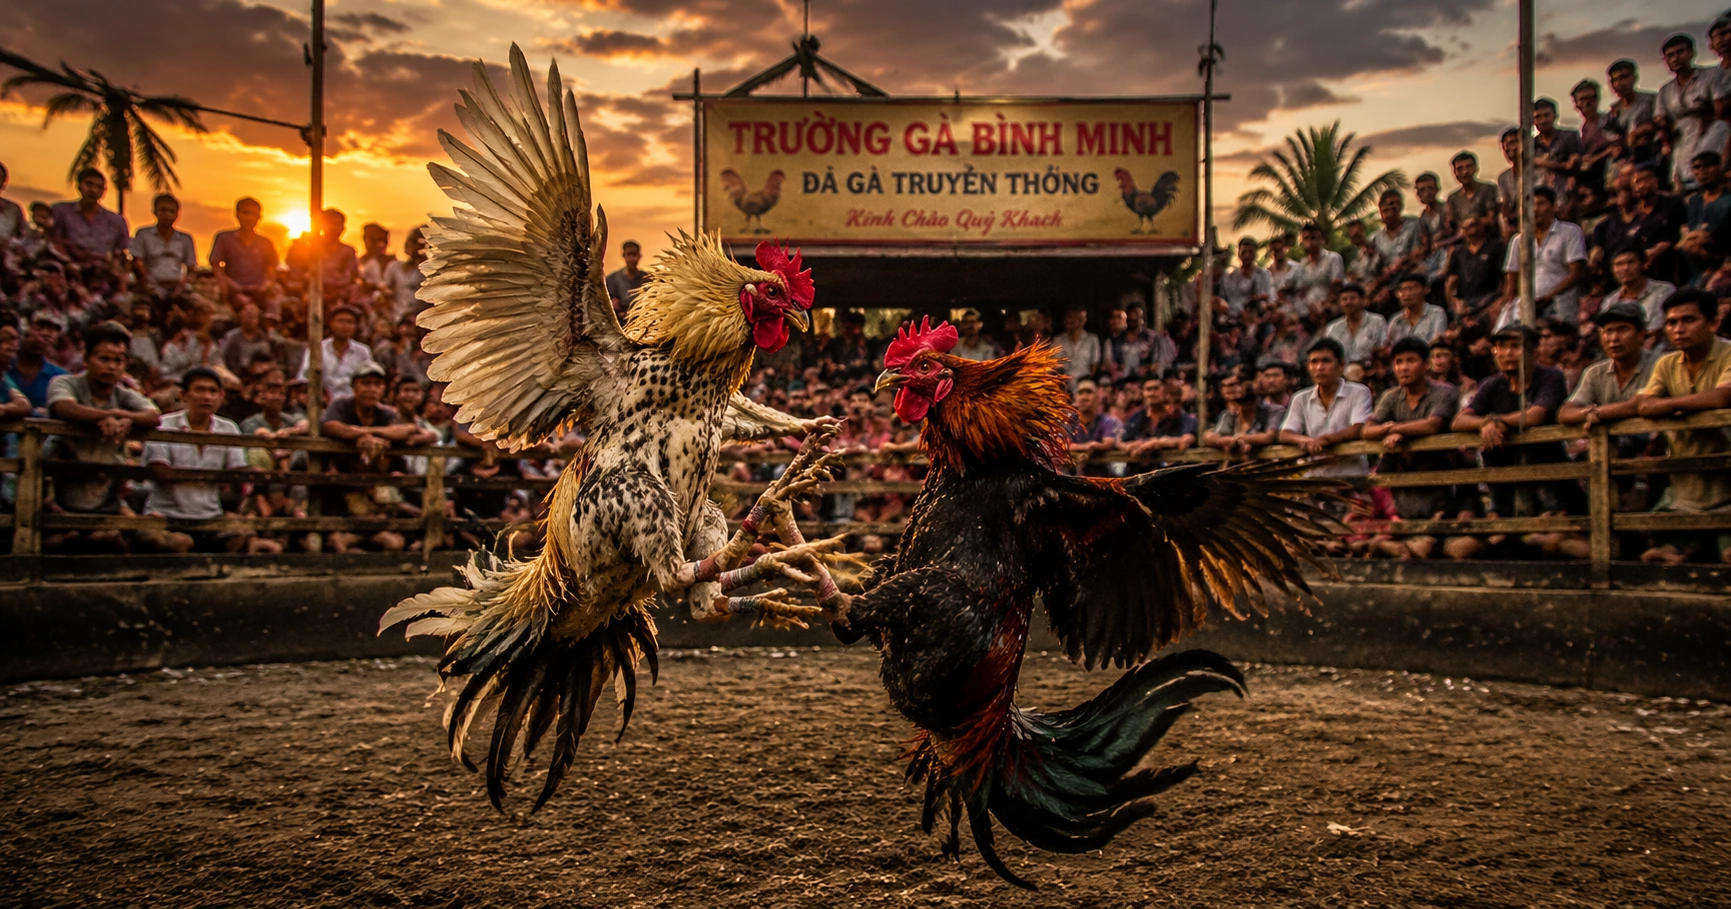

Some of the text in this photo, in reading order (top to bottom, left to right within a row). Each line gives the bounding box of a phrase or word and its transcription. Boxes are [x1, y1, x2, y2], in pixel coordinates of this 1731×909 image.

[728, 111, 1173, 156] TRƯỜNG GÀ BÌNH MINH
